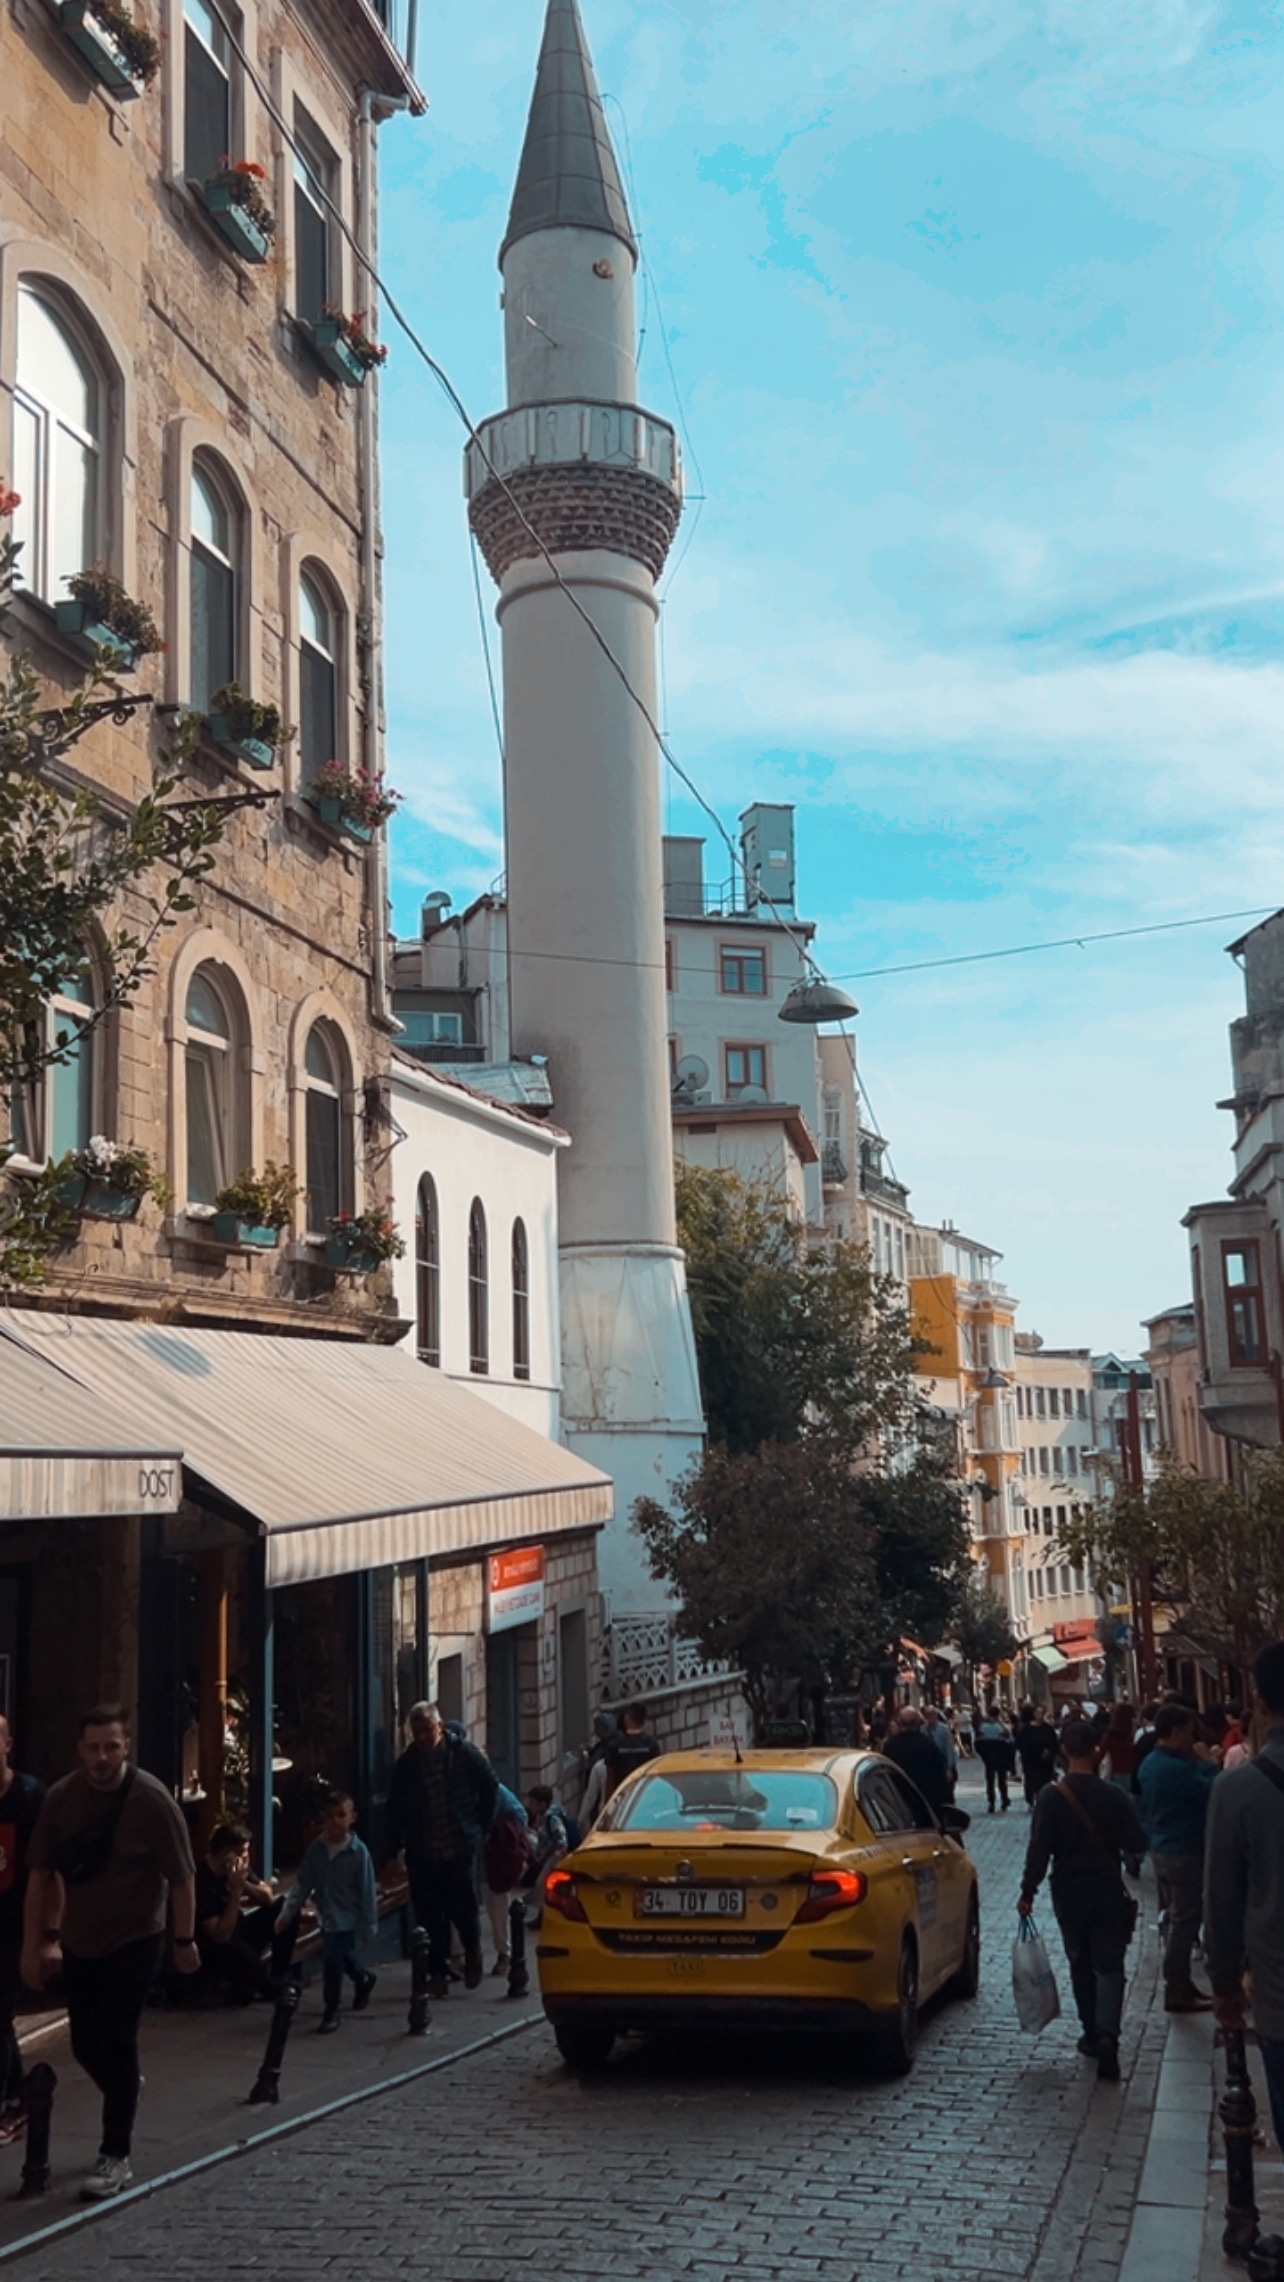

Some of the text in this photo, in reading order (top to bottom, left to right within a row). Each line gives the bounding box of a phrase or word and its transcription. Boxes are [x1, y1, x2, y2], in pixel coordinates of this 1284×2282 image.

[138, 1469, 174, 1498] DOST
[645, 1891, 739, 1911] 34 TOY 06
